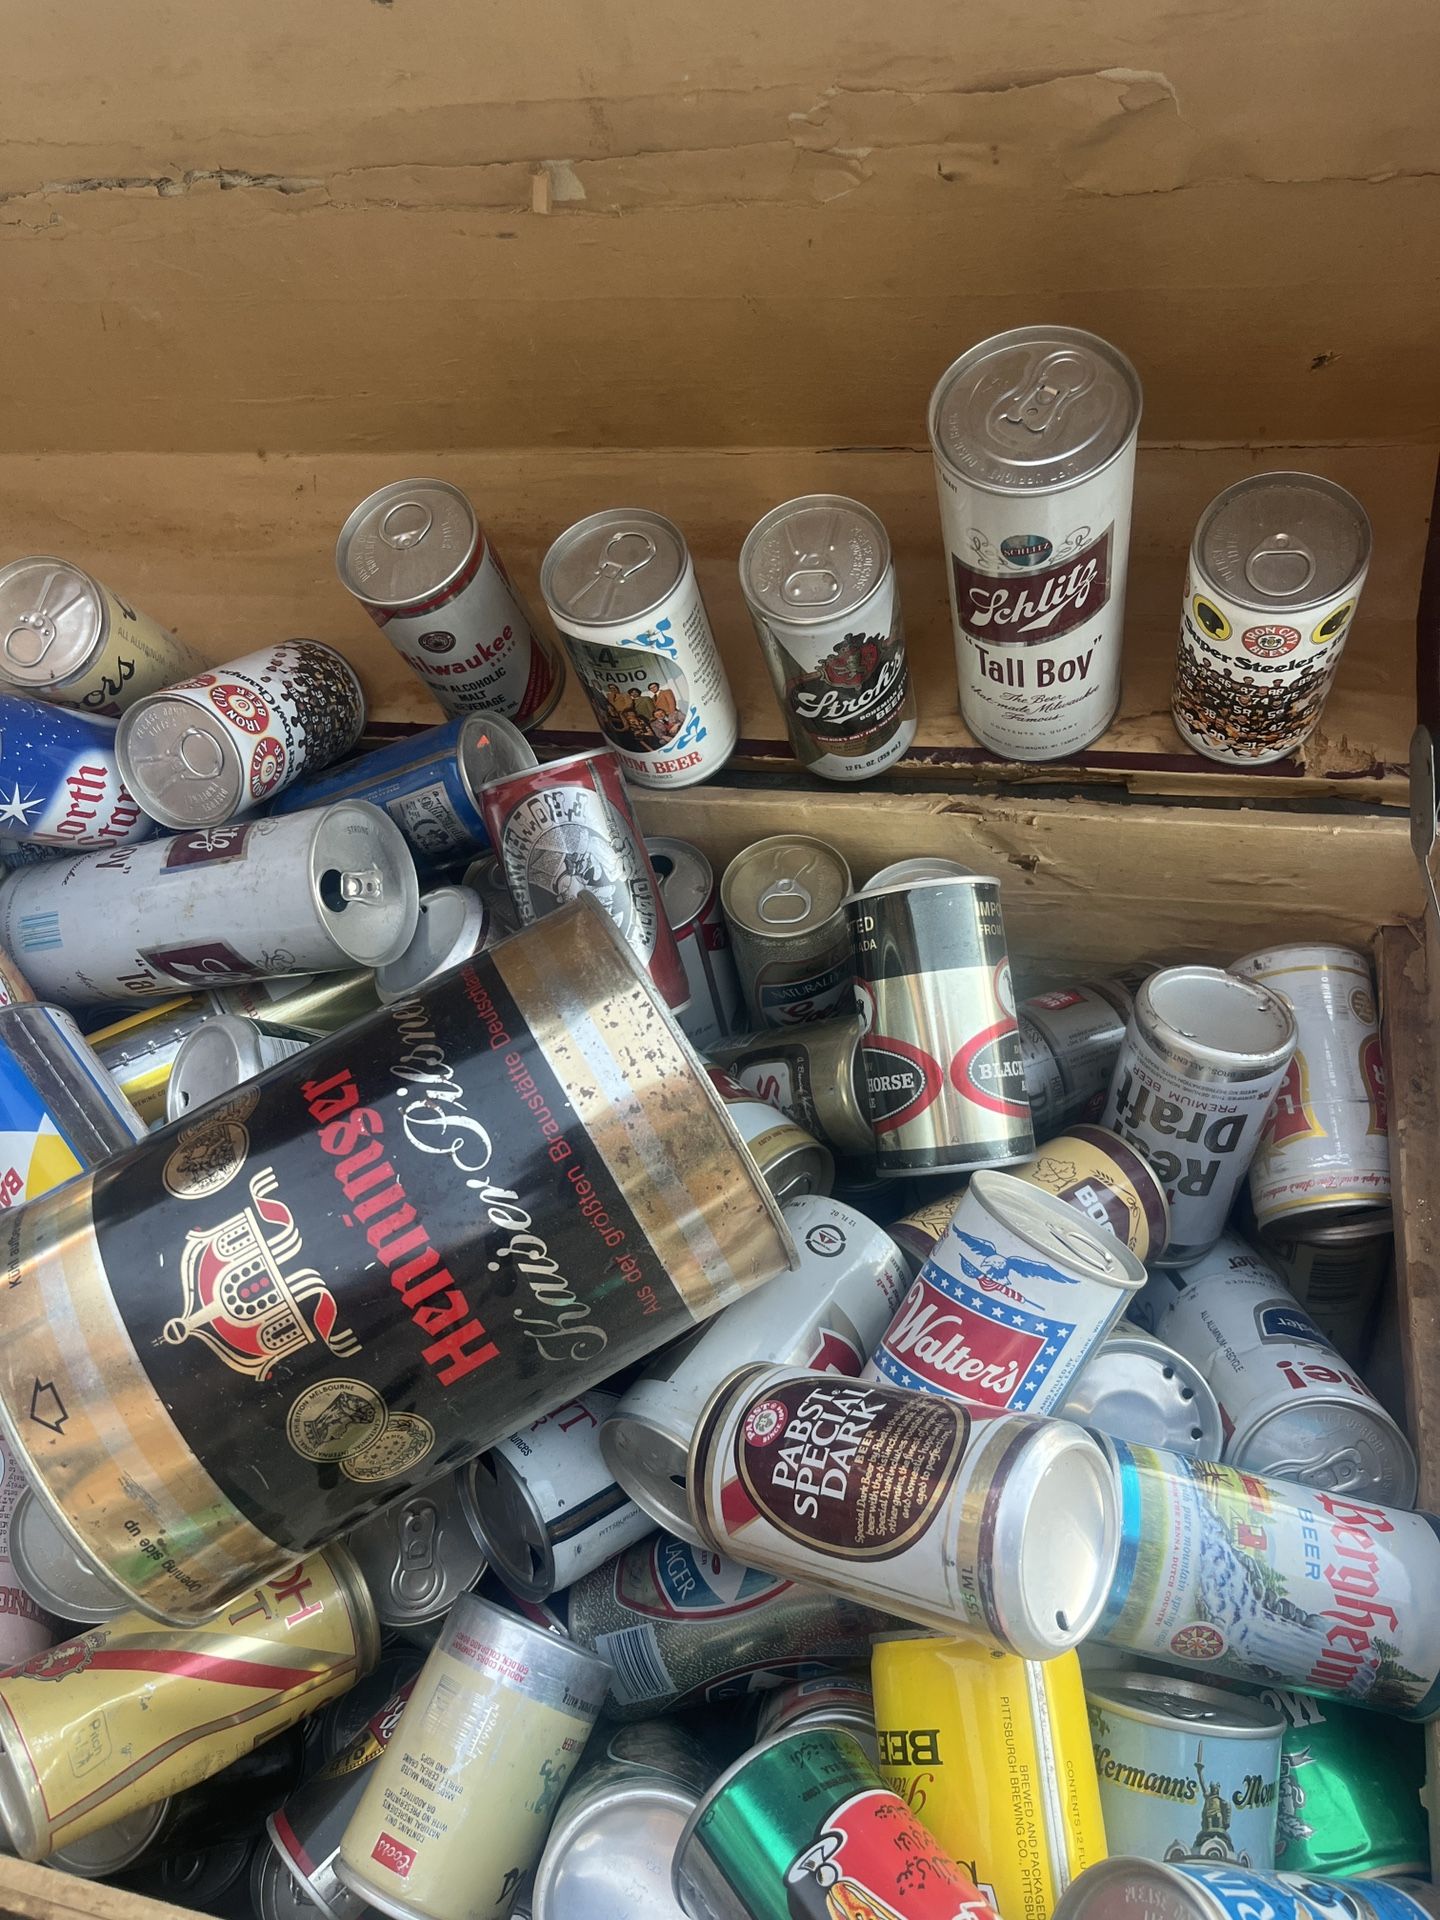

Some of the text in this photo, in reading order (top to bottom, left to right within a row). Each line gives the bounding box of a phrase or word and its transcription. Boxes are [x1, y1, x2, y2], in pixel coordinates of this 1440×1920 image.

[1003, 542, 1050, 556] SCHLITZ
[968, 557, 1099, 633] Schlitz
[1184, 615, 1328, 673] Super Steelers
[1244, 626, 1298, 645] IRON CITY
[1250, 647, 1289, 657] BEER
[450, 667, 507, 693] ALCOHOLIC
[593, 669, 647, 684] RADIO
[796, 648, 905, 722] Stroh's
[212, 687, 261, 732] IRON CITY
[220, 670, 294, 749] Bowl Champs
[236, 687, 266, 716] BEER
[452, 694, 506, 711] BEVERAGE
[458, 690, 487, 702] MALT
[860, 691, 897, 720] BOHEMIAN
[876, 691, 903, 721] BEER
[1000, 692, 1066, 705] The Beer
[1030, 684, 1099, 714] Milwaukee
[990, 722, 1078, 736] CONTENTS QUART
[252, 741, 268, 798] IRON CITY
[273, 745, 285, 781] BEER
[653, 752, 703, 773] BEER
[347, 826, 369, 835] STRONG
[867, 1073, 915, 1092] HORSE
[978, 1060, 1026, 1080] BLACK
[1133, 1067, 1238, 1114] PREMIUM BEER
[1116, 1066, 1249, 1154] Draft
[504, 1051, 664, 1317] Aus der größten Braustätte
[300, 1066, 501, 1387] Henninger
[841, 1214, 849, 1222] FL
[848, 1219, 857, 1228] 12
[6, 1257, 24, 1290] Kühl
[465, 1175, 609, 1364] Kaiser
[888, 1279, 1019, 1395] Walter's
[1200, 1311, 1244, 1373] ALL ALUMINUM RECYCLE
[1040, 1358, 1074, 1411] AND FILLED BY
[294, 1383, 382, 1458] CENTENNIAL INTERNATIONAL EXHIBITION MELBOURNE
[746, 1402, 771, 1441] PABST
[762, 1423, 782, 1443] SINCE
[772, 1388, 835, 1490] PABST
[793, 1388, 875, 1520] SPECIAL
[820, 1400, 888, 1501] DARK
[854, 1429, 878, 1465] BEER
[855, 1432, 886, 1543] Special Dark Beer by Pabst
[865, 1428, 903, 1536] beer with the distinctive
[875, 1440, 909, 1536] Special Dark includes
[904, 1450, 925, 1498] domestic
[915, 1470, 931, 1505] aged to
[888, 1508, 899, 1534] other
[898, 1459, 911, 1474] the
[902, 1498, 912, 1519] and
[124, 1518, 202, 1593] Opening side up
[1295, 1508, 1320, 1581] BEER
[665, 1543, 696, 1600] LAGER
[1163, 1505, 1192, 1628] pure mountain spring
[1168, 1555, 1180, 1589] DUTCH
[961, 1565, 982, 1620] 355 ML
[1155, 1591, 1172, 1628] COUNTRY
[1306, 1493, 1398, 1690] Bergheim
[470, 1638, 499, 1661] COLORADO
[476, 1653, 497, 1669] COORS
[497, 1665, 525, 1683] ADOLPH
[400, 1764, 437, 1792] FROM MALTED
[420, 1753, 448, 1774] AND HOPS
[420, 1765, 440, 1780] CEREAL
[382, 1799, 441, 1839] NATURAL INGREDIENTS
[384, 1788, 448, 1832] WITH NO PRESERVATIVES
[400, 1786, 436, 1815] OR ADDITIVES
[1000, 1696, 1036, 1920] PITTSBURGH BREWING CO., PITTSBU
[1066, 1760, 1084, 1844] CONTENTS 12
[385, 1814, 425, 1844] CONTAINS ONLY
[1019, 1764, 1047, 1920] BREWED AND PACKAGED
[378, 1840, 411, 1870] Coors
